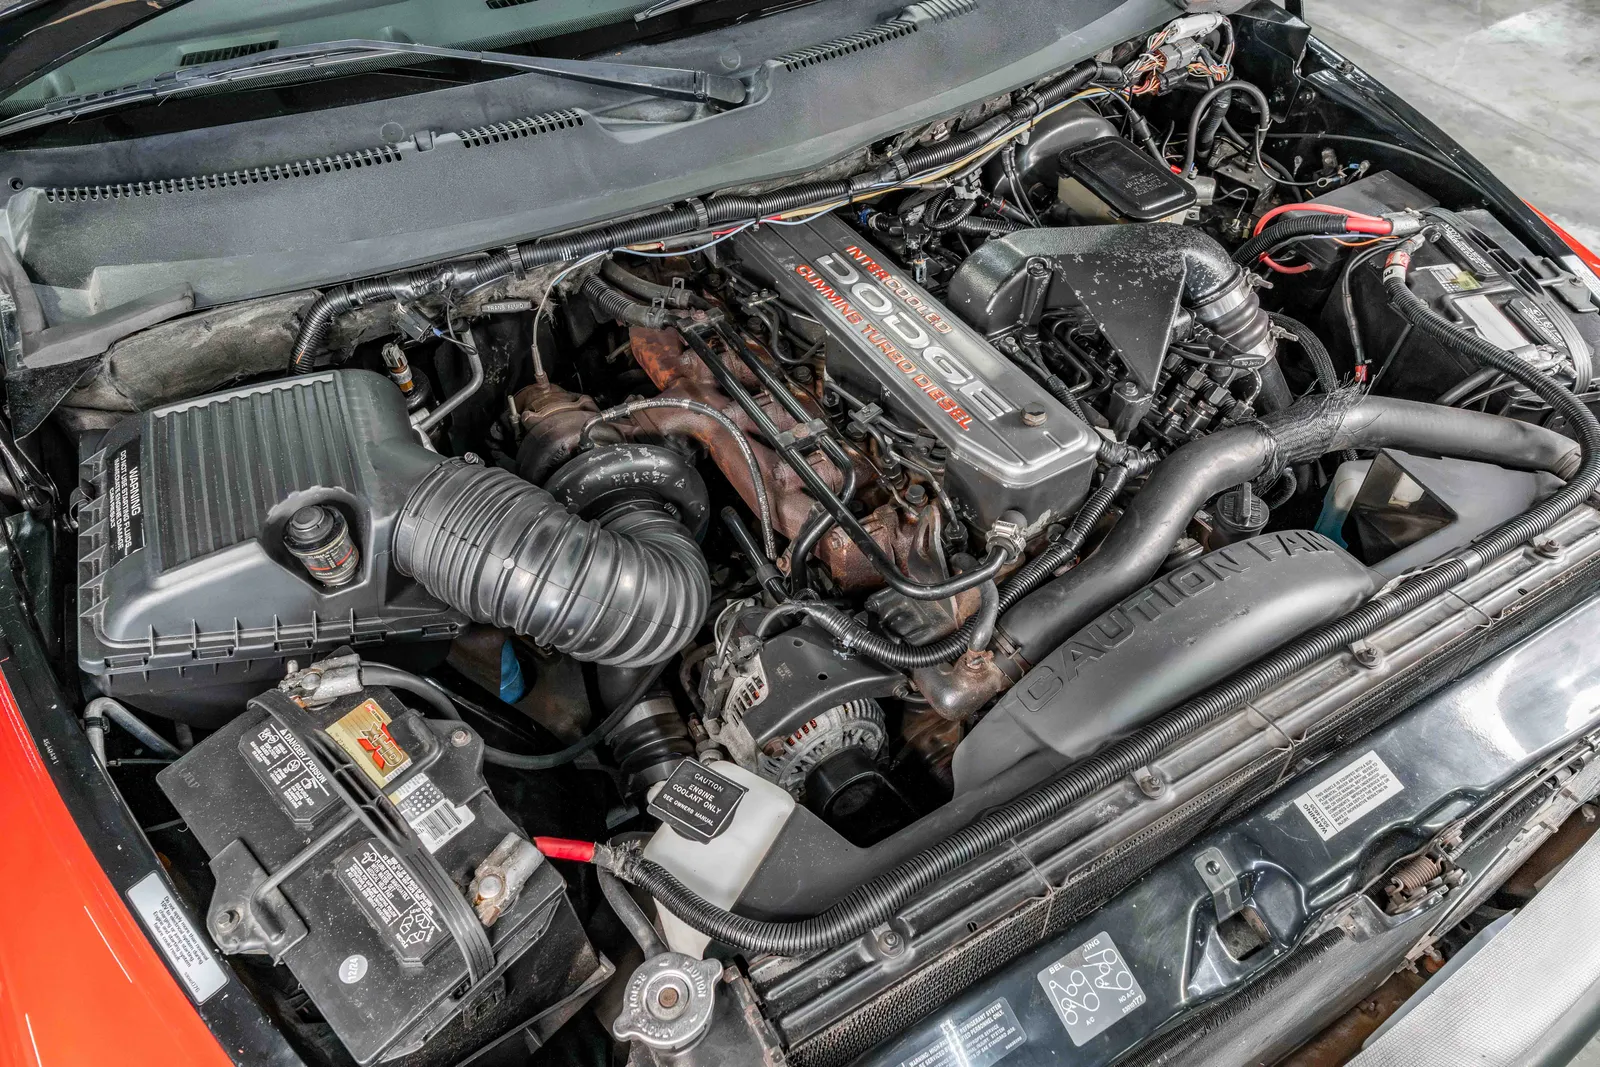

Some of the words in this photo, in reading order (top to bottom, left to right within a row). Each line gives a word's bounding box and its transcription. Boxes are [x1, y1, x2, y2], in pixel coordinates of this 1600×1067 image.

[845, 245, 953, 334] INTERCOOLED
[795, 264, 864, 326] CUMMINS
[861, 323, 917, 375] TURBO
[912, 374, 973, 431] DIESEL
[815, 252, 1013, 421] DODGE
[121, 450, 126, 460] DO
[122, 488, 130, 521] STARTING
[129, 466, 141, 516] WARNING
[1016, 550, 1251, 712] CAUTION
[1247, 530, 1334, 562] FAN
[284, 733, 307, 758] DANGER
[306, 760, 327, 783] POISON
[672, 782, 703, 805] COOLANT
[703, 800, 722, 815] ONLY
[688, 783, 715, 803] ENGINE
[694, 772, 724, 794] CAUTION
[662, 793, 674, 803] SEE
[673, 799, 694, 815] OWNERS
[694, 811, 715, 826] MANUAL
[1302, 803, 1328, 834] WARNING
[152, 911, 165, 926] Engine
[162, 925, 170, 935] and
[168, 934, 182, 952] starting
[178, 950, 192, 968] system
[153, 922, 164, 936] failure
[162, 936, 172, 948] could
[158, 909, 172, 928] charging
[173, 932, 183, 944] jump
[169, 915, 185, 935] electrical
[182, 934, 195, 951] system
[192, 949, 204, 965] during
[173, 910, 183, 923] apply
[181, 922, 190, 934] more
[189, 933, 198, 944] than
[196, 943, 209, 961] nominal
[682, 961, 708, 998] CAUTION
[1118, 995, 1127, 1003] NO
[958, 1013, 987, 1034] REFRIGERANT
[985, 1002, 1003, 1017] SYSTEM
[969, 1017, 994, 1035] PERSONNEL
